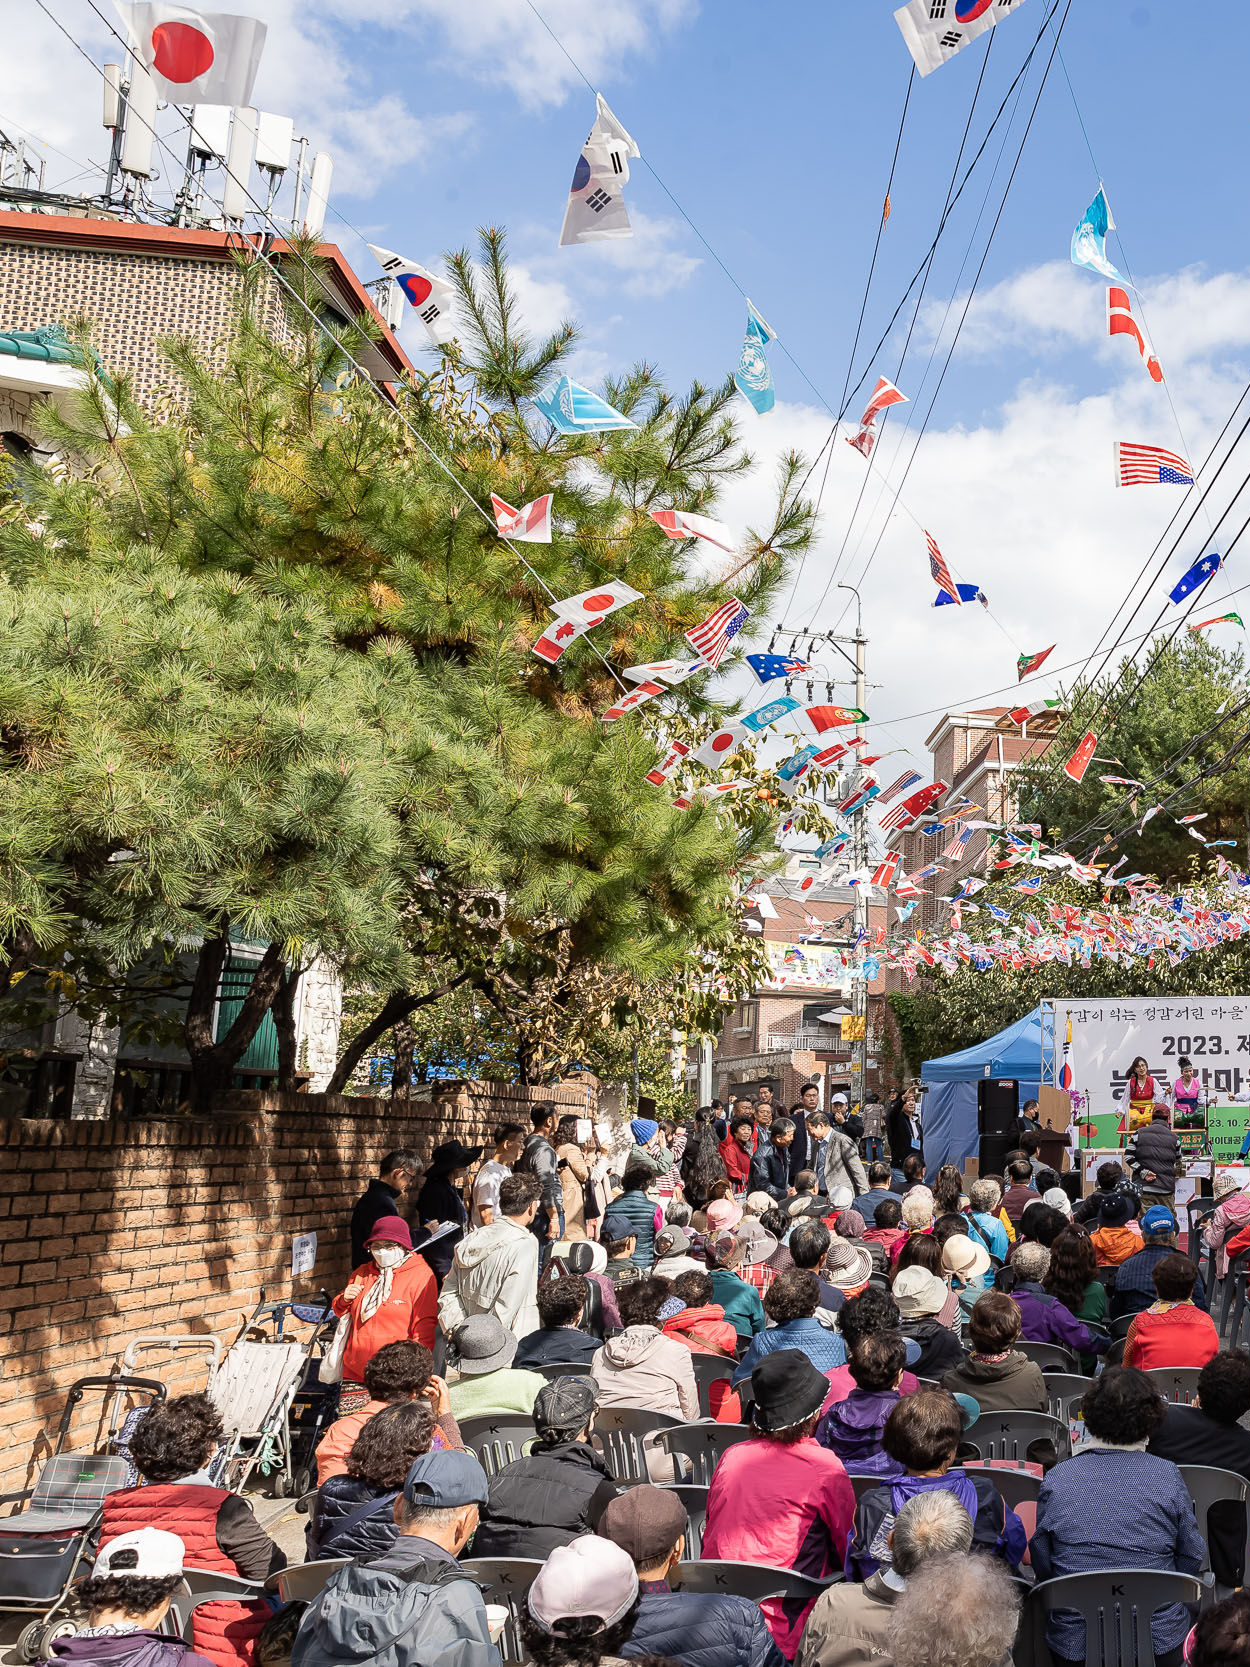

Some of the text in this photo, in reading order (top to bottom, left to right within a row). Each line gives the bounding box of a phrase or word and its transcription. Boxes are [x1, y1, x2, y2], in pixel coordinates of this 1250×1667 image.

[1142, 1006, 1204, 1021] 정감어린
[1162, 1035, 1230, 1056] 2023.
[1227, 1119, 1241, 1128] 10.
[1174, 1376, 1182, 1384] K
[615, 1415, 624, 1424] K
[489, 1424, 500, 1434] K
[1000, 1423, 1010, 1433] K
[707, 1433, 717, 1442] K
[500, 1573, 513, 1584] K
[715, 1574, 728, 1585] K
[1111, 1584, 1125, 1596] K
